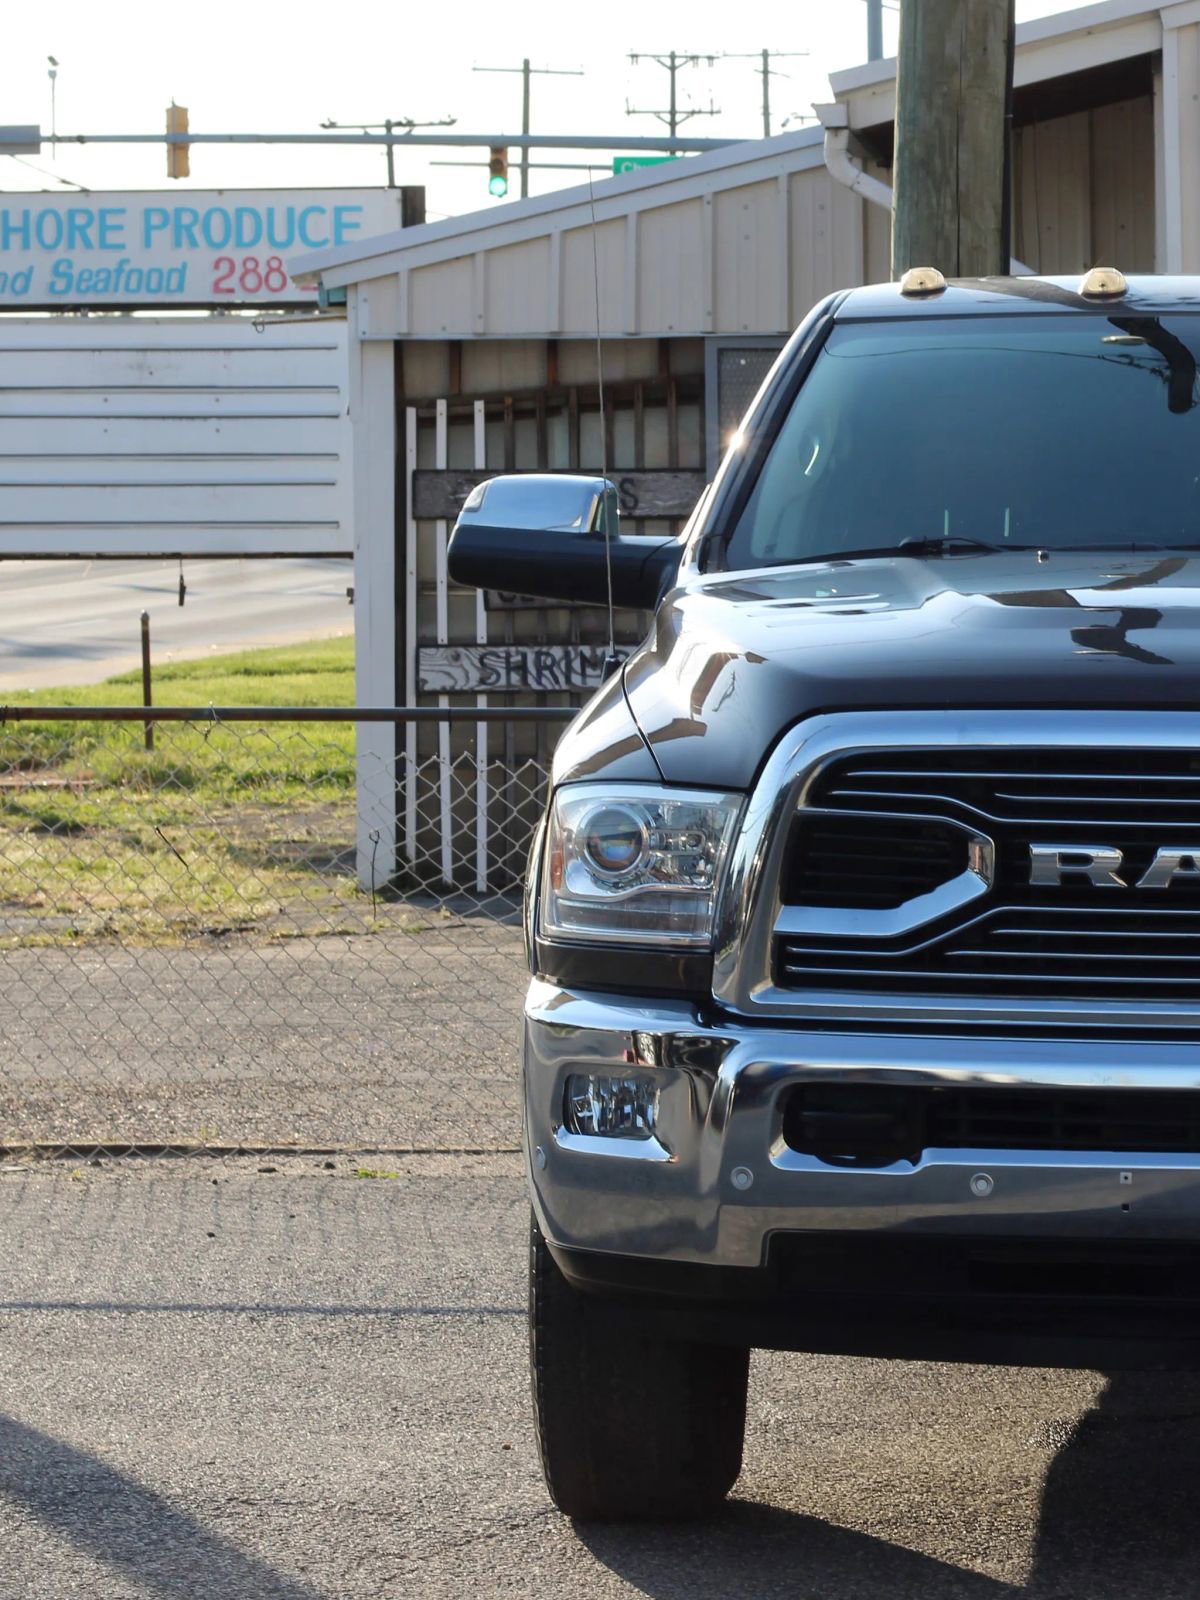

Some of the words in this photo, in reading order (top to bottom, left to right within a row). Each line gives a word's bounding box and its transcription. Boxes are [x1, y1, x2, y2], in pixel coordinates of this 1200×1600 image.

[1, 208, 127, 251] HORE
[143, 206, 364, 250] PRODUCE
[48, 257, 188, 296] Seafood
[212, 256, 319, 294] 288
